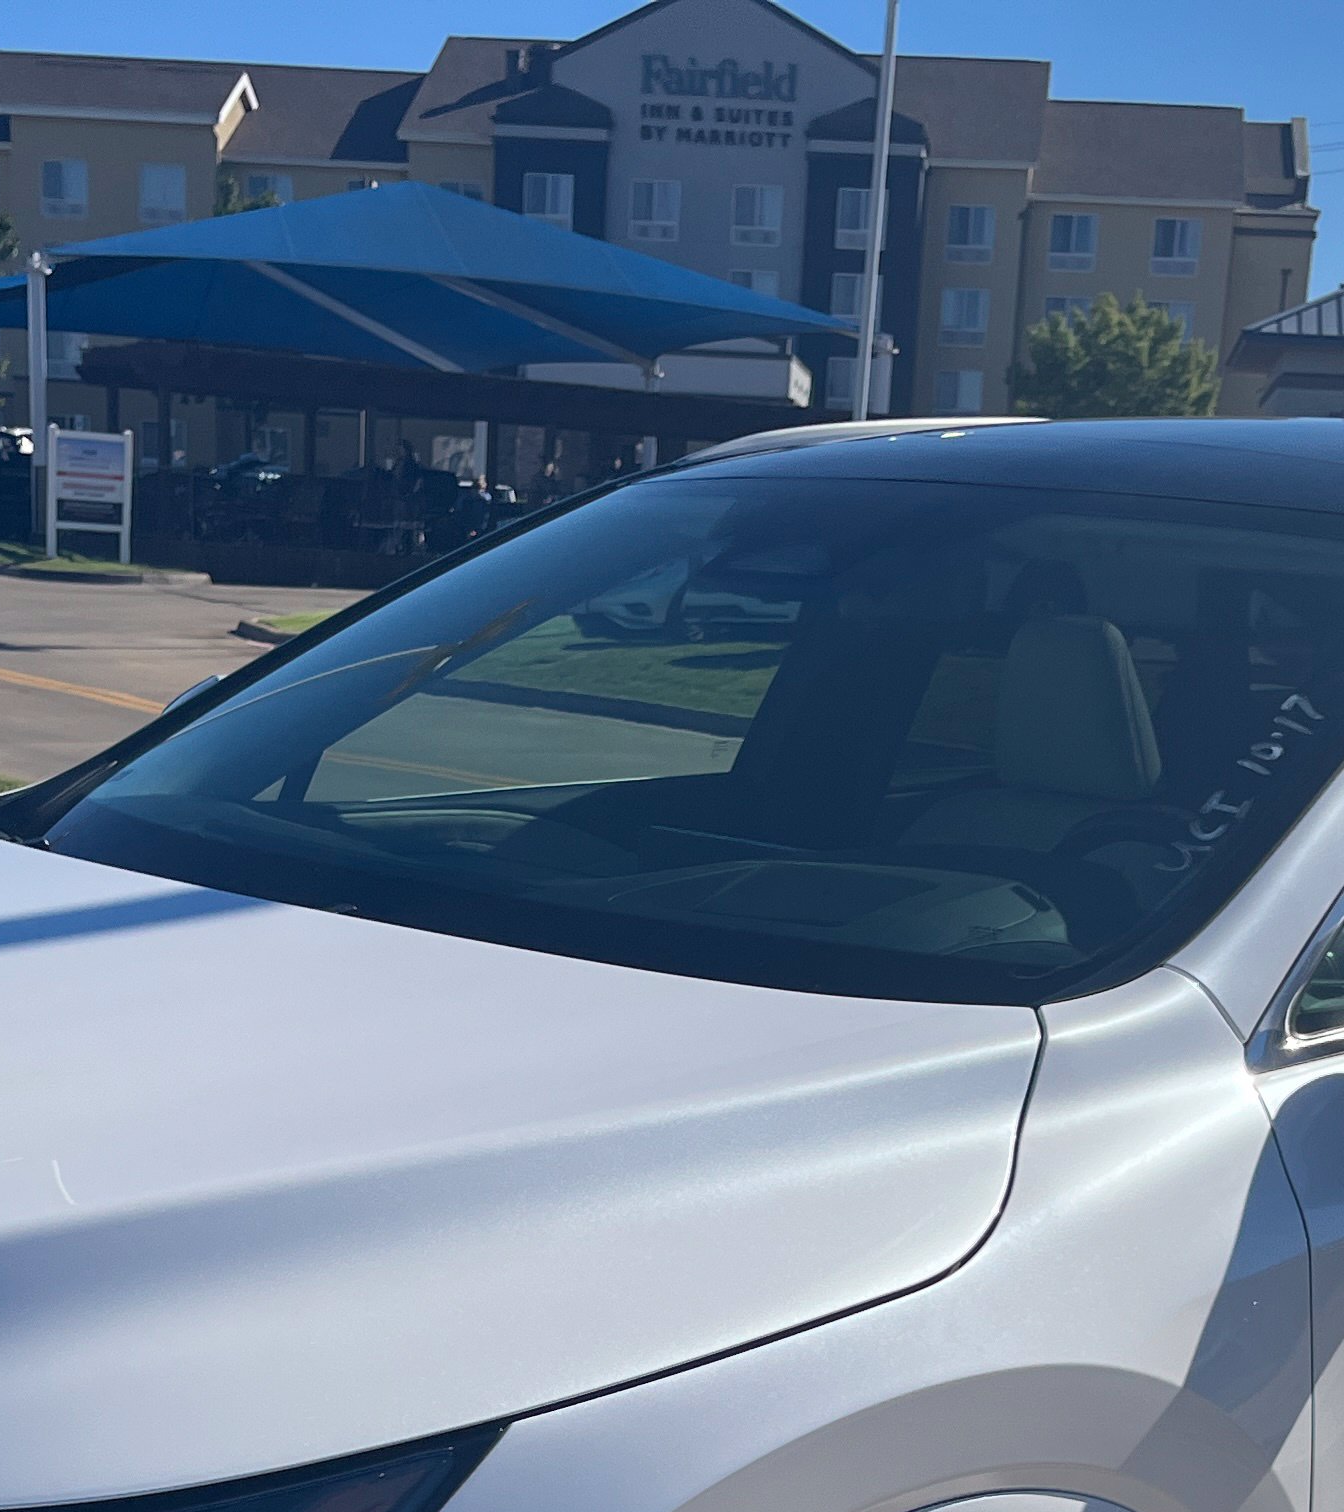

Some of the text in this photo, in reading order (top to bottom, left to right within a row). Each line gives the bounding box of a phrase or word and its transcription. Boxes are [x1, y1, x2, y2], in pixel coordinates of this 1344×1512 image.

[640, 54, 798, 102] Fairfield
[641, 103, 794, 126] INN & SUITES
[641, 124, 792, 148] BY MARRIOTT
